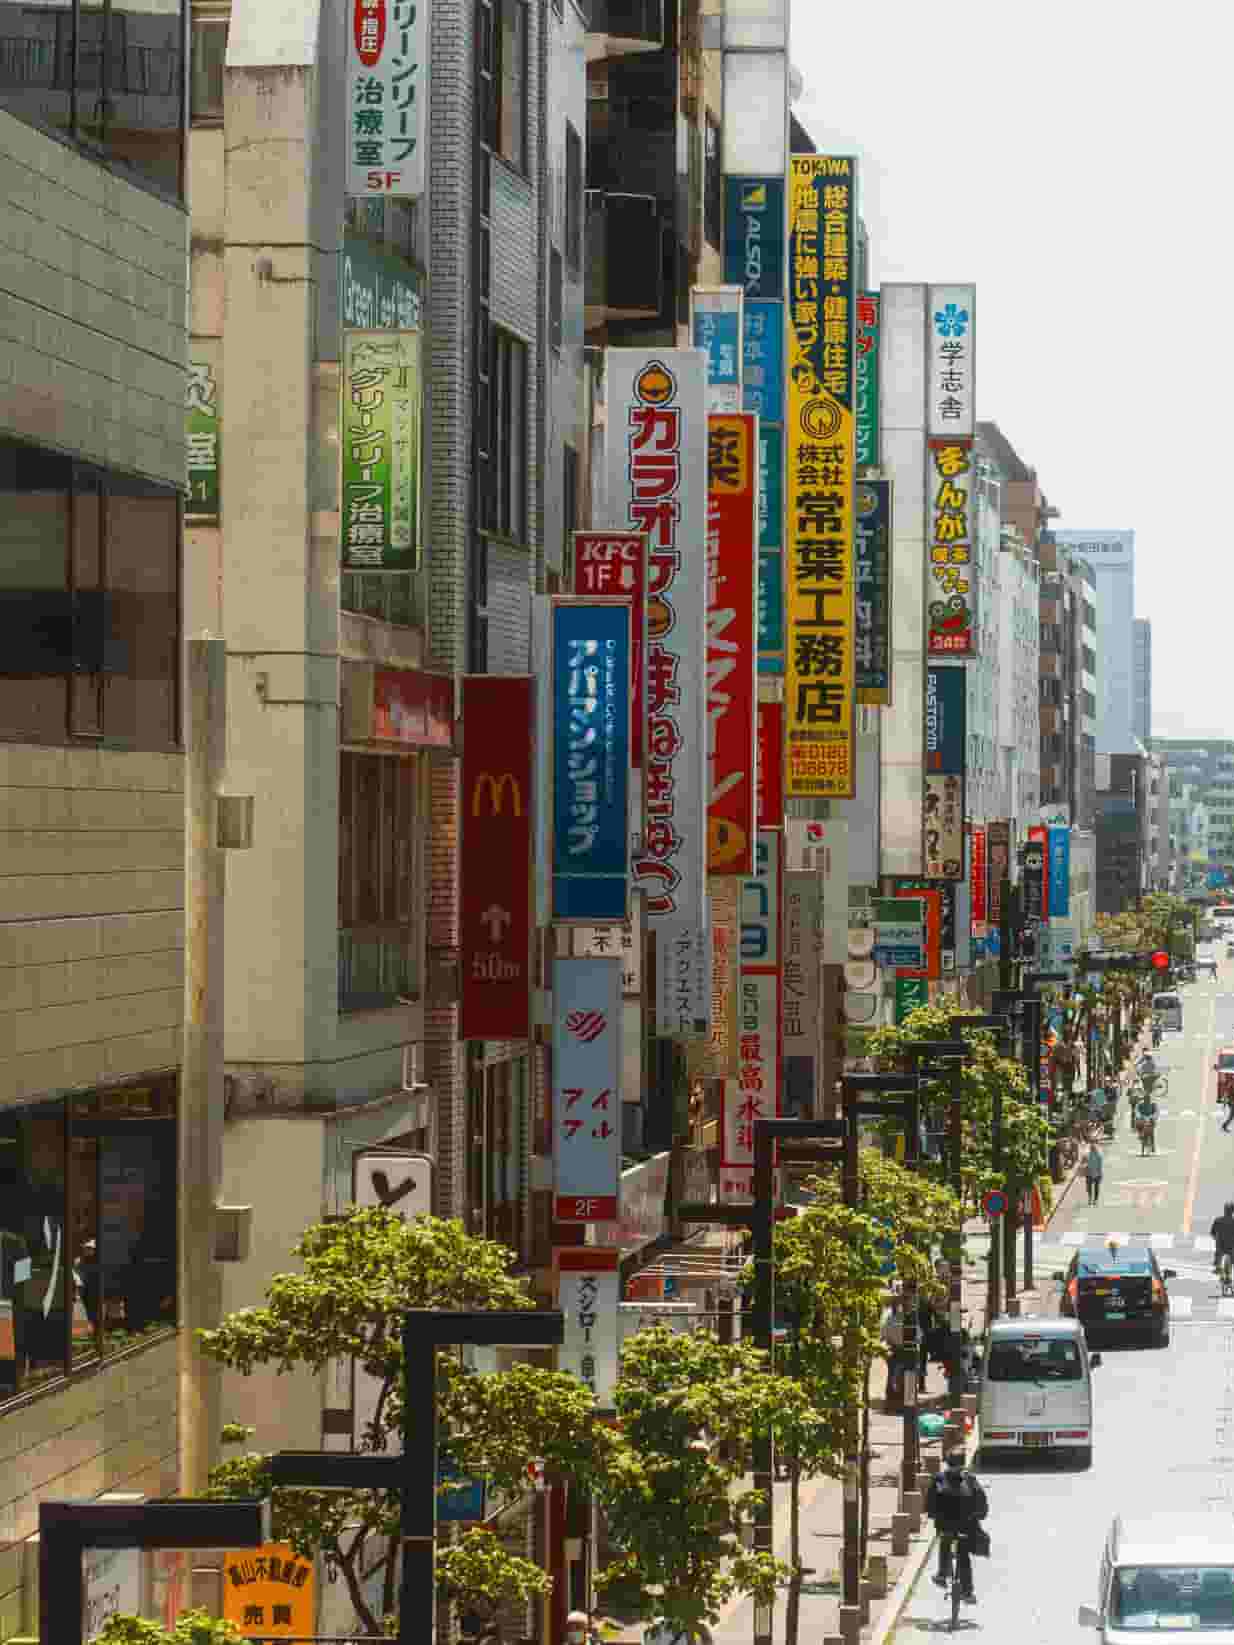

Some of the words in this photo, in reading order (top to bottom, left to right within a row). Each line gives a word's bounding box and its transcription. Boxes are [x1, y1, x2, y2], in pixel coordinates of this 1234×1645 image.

[351, 75, 385, 167] 治療室
[390, 0, 419, 161] リーンリーフ
[366, 170, 402, 190] 5F
[791, 159, 849, 176] TOKIWA
[743, 213, 762, 297] ALSOK
[792, 187, 820, 398] 地震に強い家づくり
[822, 184, 849, 395] 総合建築・健康住宅
[939, 340, 965, 421] 学志舎
[630, 406, 682, 594] カラオケ
[935, 446, 970, 543] まんが
[581, 541, 639, 561] KFC
[585, 564, 613, 590] 1F
[795, 491, 846, 725] 常葉工務店
[574, 1200, 598, 1217] 2F
